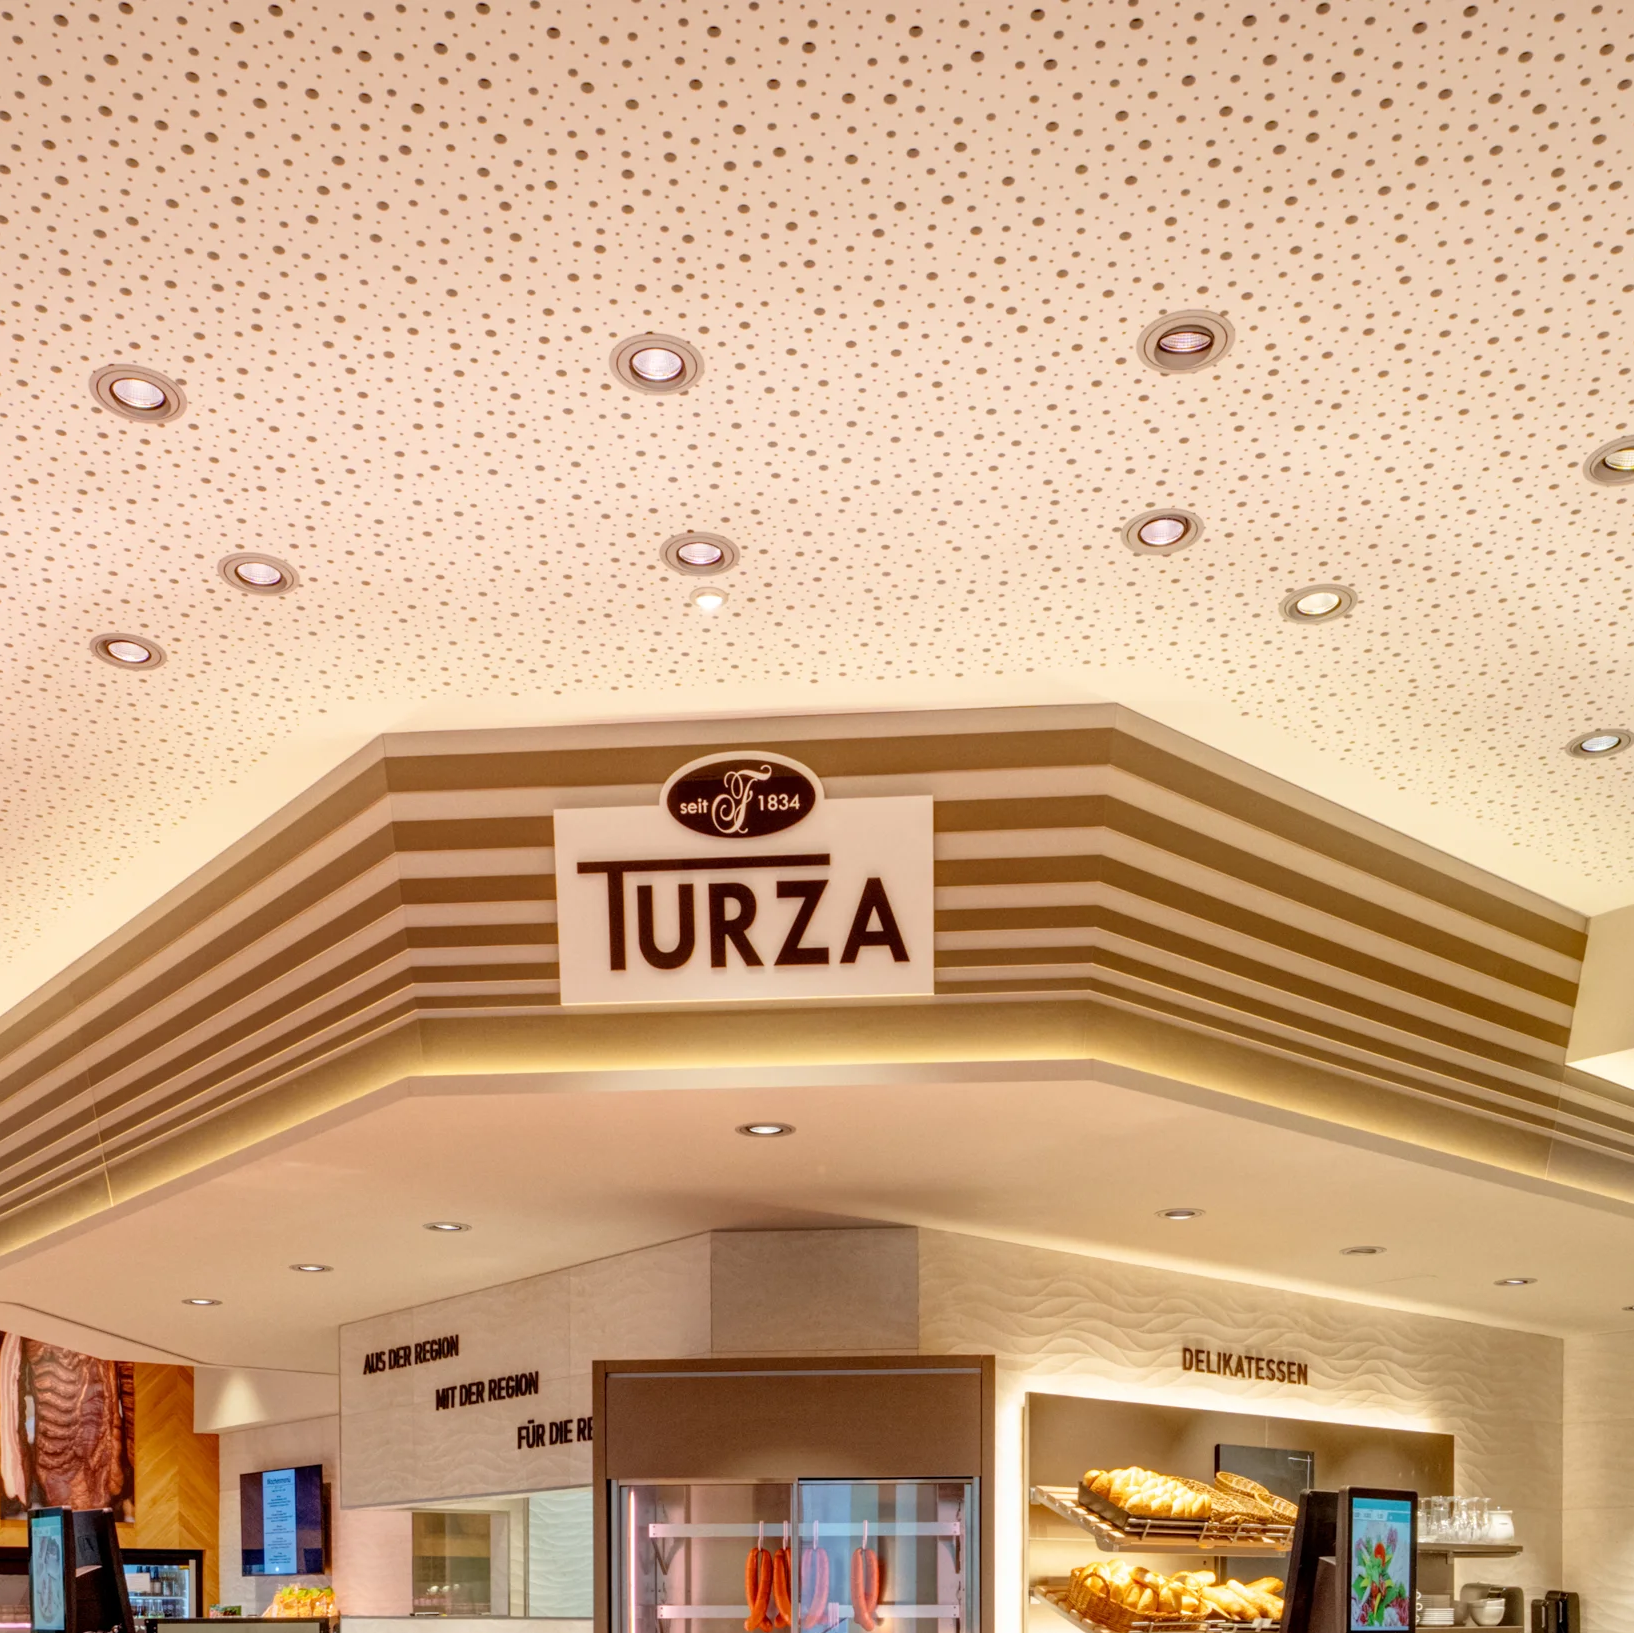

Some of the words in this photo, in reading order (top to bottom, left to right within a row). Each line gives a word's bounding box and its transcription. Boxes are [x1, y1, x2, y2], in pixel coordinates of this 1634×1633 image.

[679, 797, 709, 816] seit
[757, 792, 801, 813] 1834
[576, 853, 911, 972] TURZA
[363, 1350, 386, 1376] AUS
[388, 1345, 412, 1371] DER
[414, 1333, 460, 1365] REGION
[1182, 1346, 1309, 1386] DELIKATESSEN
[435, 1385, 457, 1411] MIT
[459, 1380, 486, 1407] DER
[488, 1370, 540, 1402] REGION
[517, 1418, 546, 1450] FÜR
[549, 1418, 574, 1446] DIE
